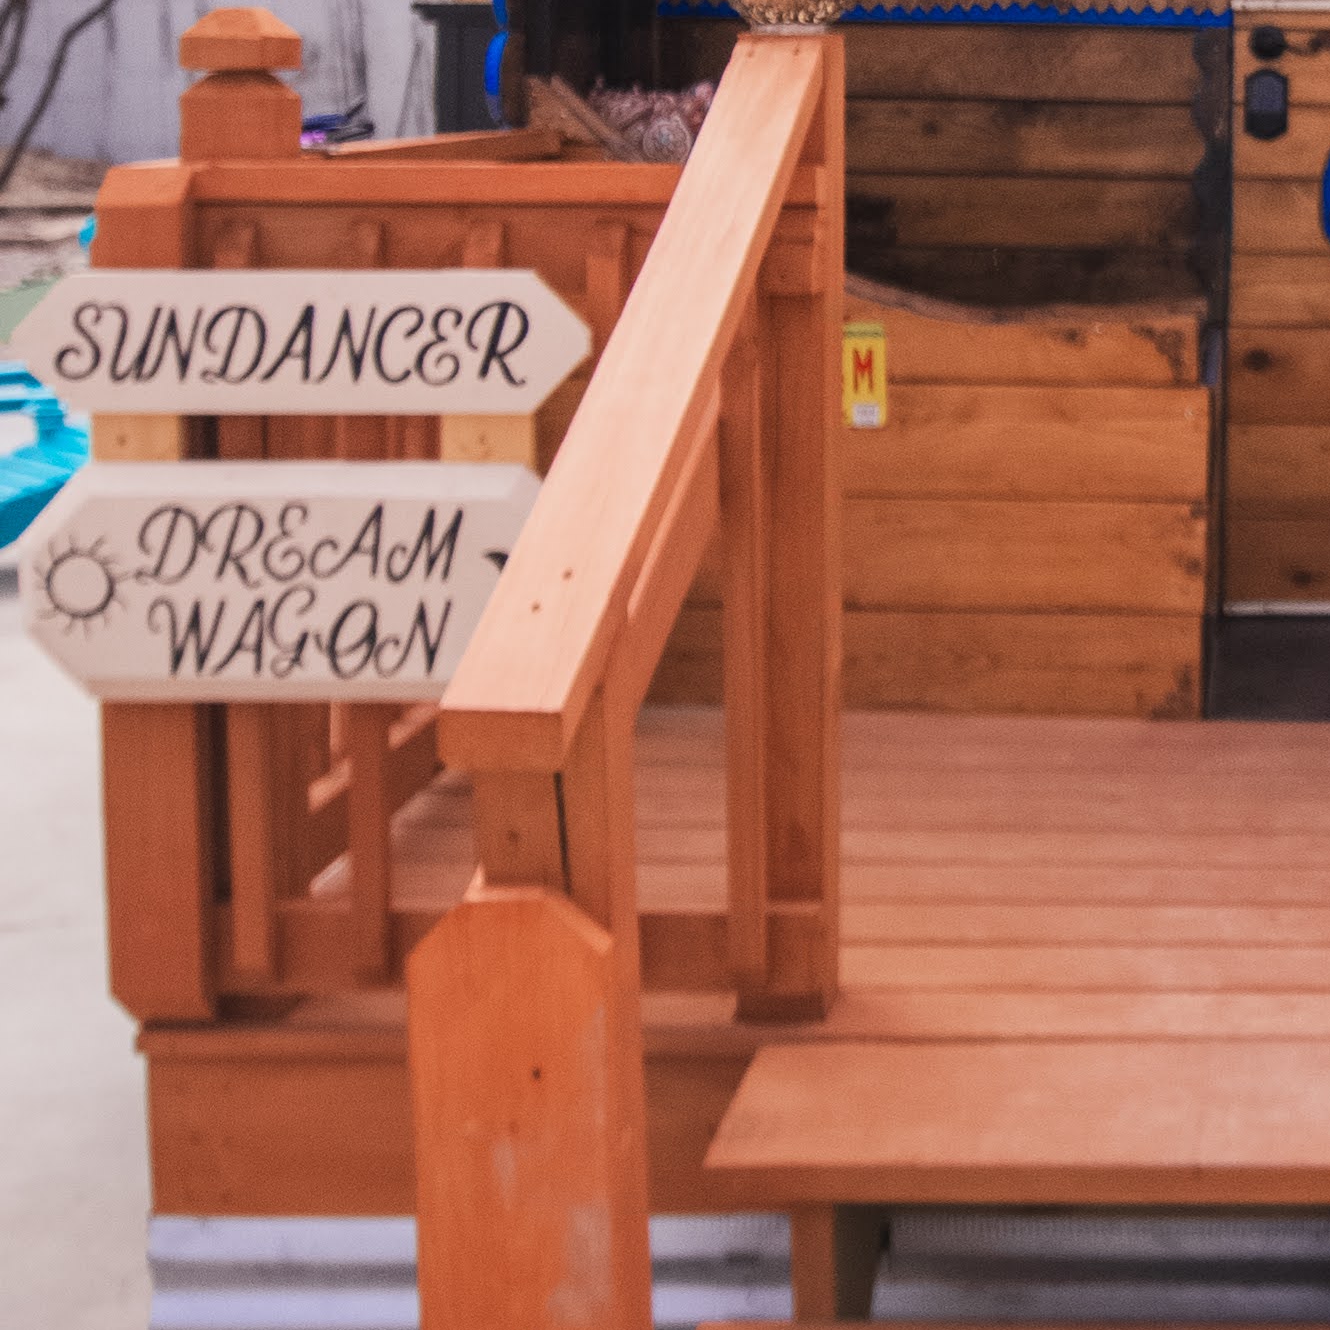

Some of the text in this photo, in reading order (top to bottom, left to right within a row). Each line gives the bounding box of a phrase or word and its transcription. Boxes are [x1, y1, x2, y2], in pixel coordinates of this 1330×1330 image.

[53, 300, 530, 386] SUNDANCER
[134, 503, 464, 585] DREAM
[147, 585, 452, 679] WAGON
